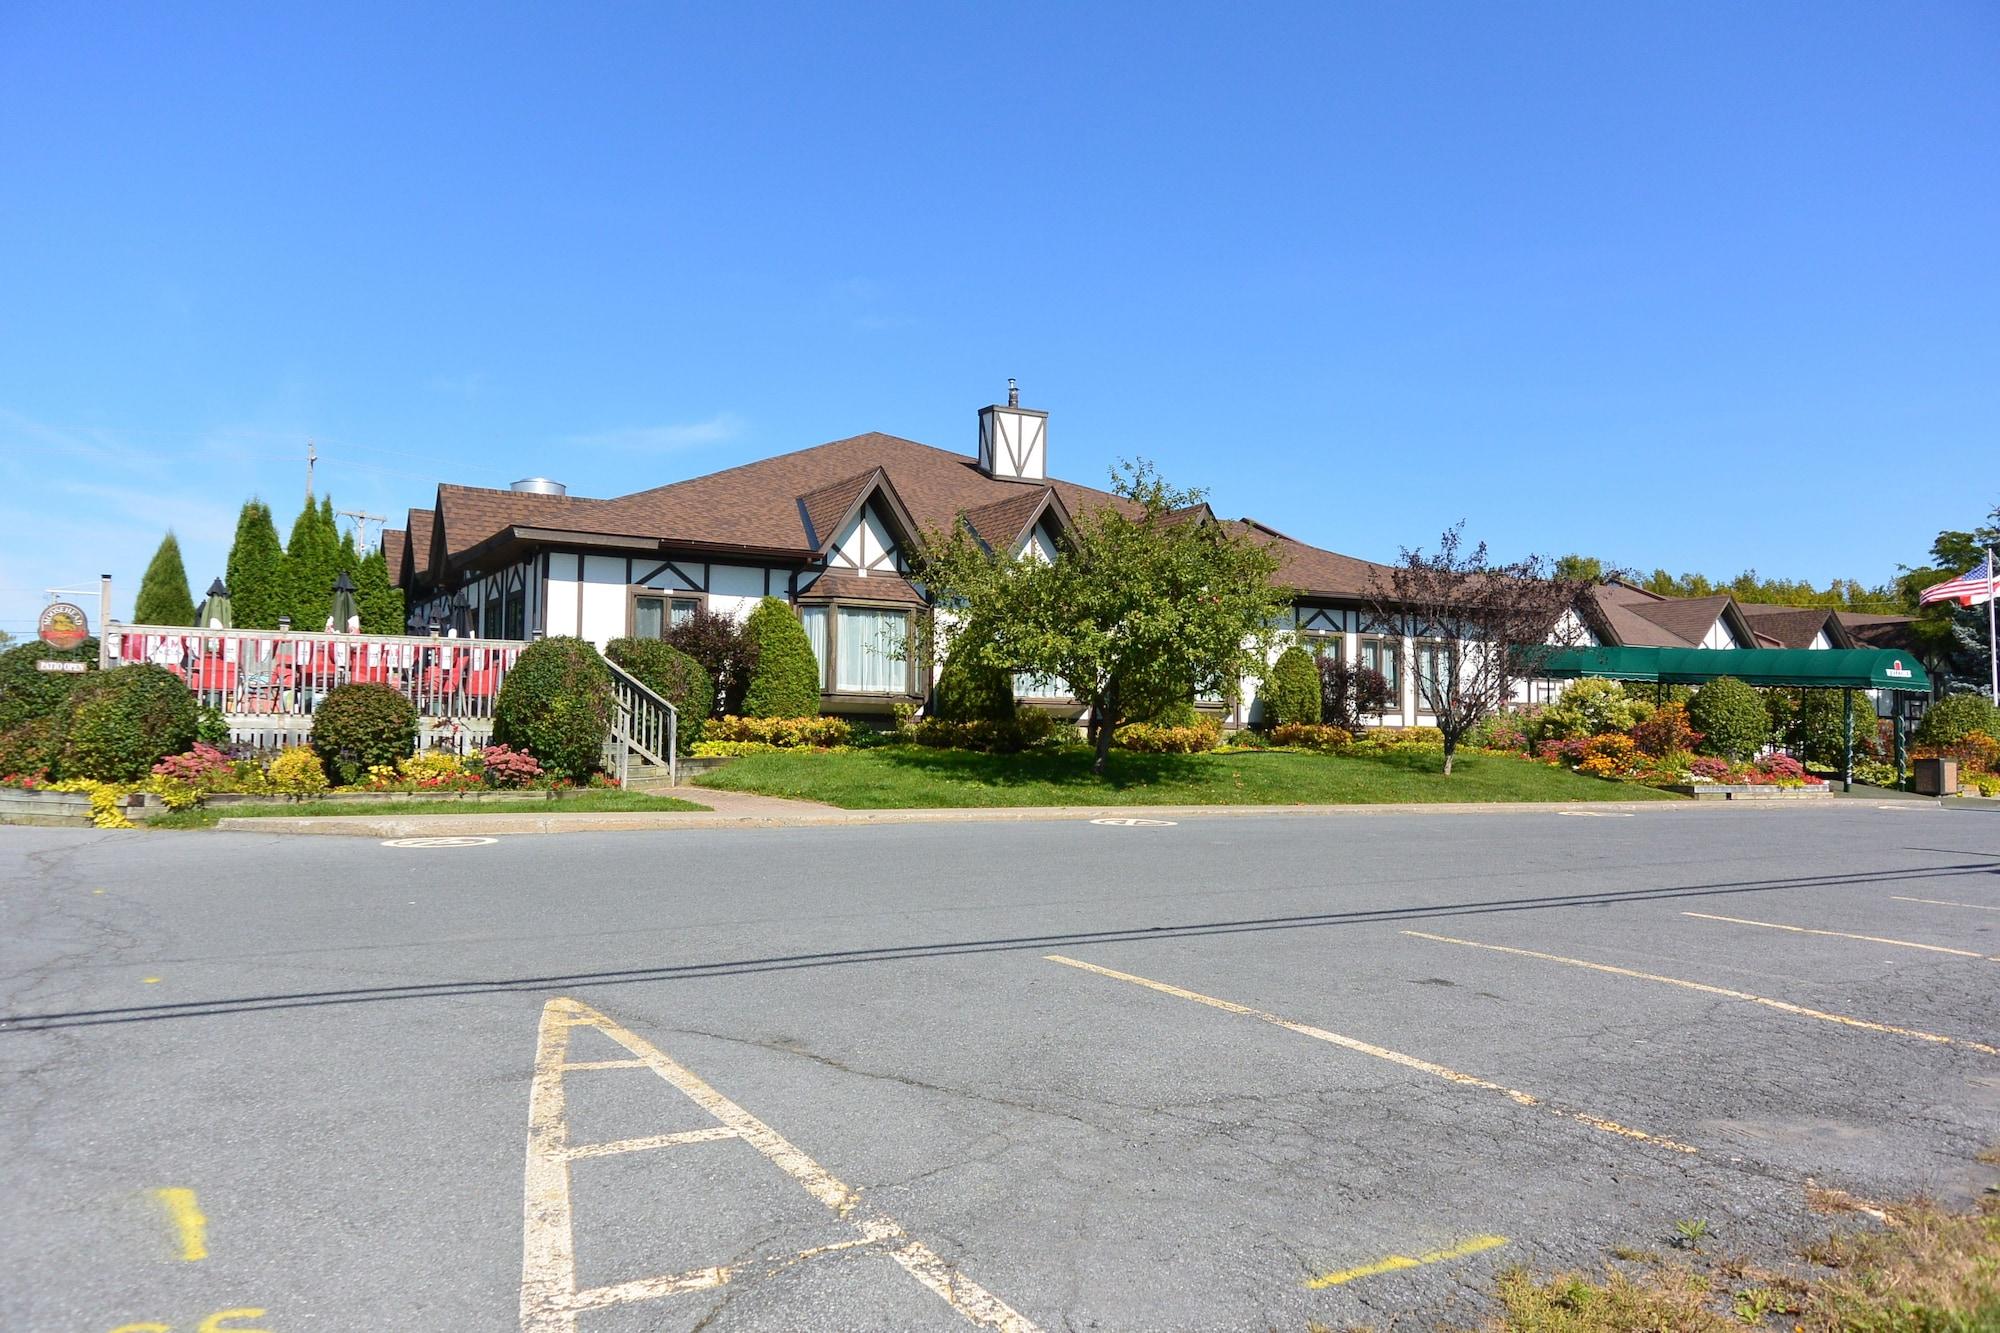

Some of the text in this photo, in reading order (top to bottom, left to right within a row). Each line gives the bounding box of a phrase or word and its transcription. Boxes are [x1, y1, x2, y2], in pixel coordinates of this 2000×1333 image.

[43, 606, 83, 625] MOOSEHEAD
[40, 662, 84, 671] PATIO OPEN
